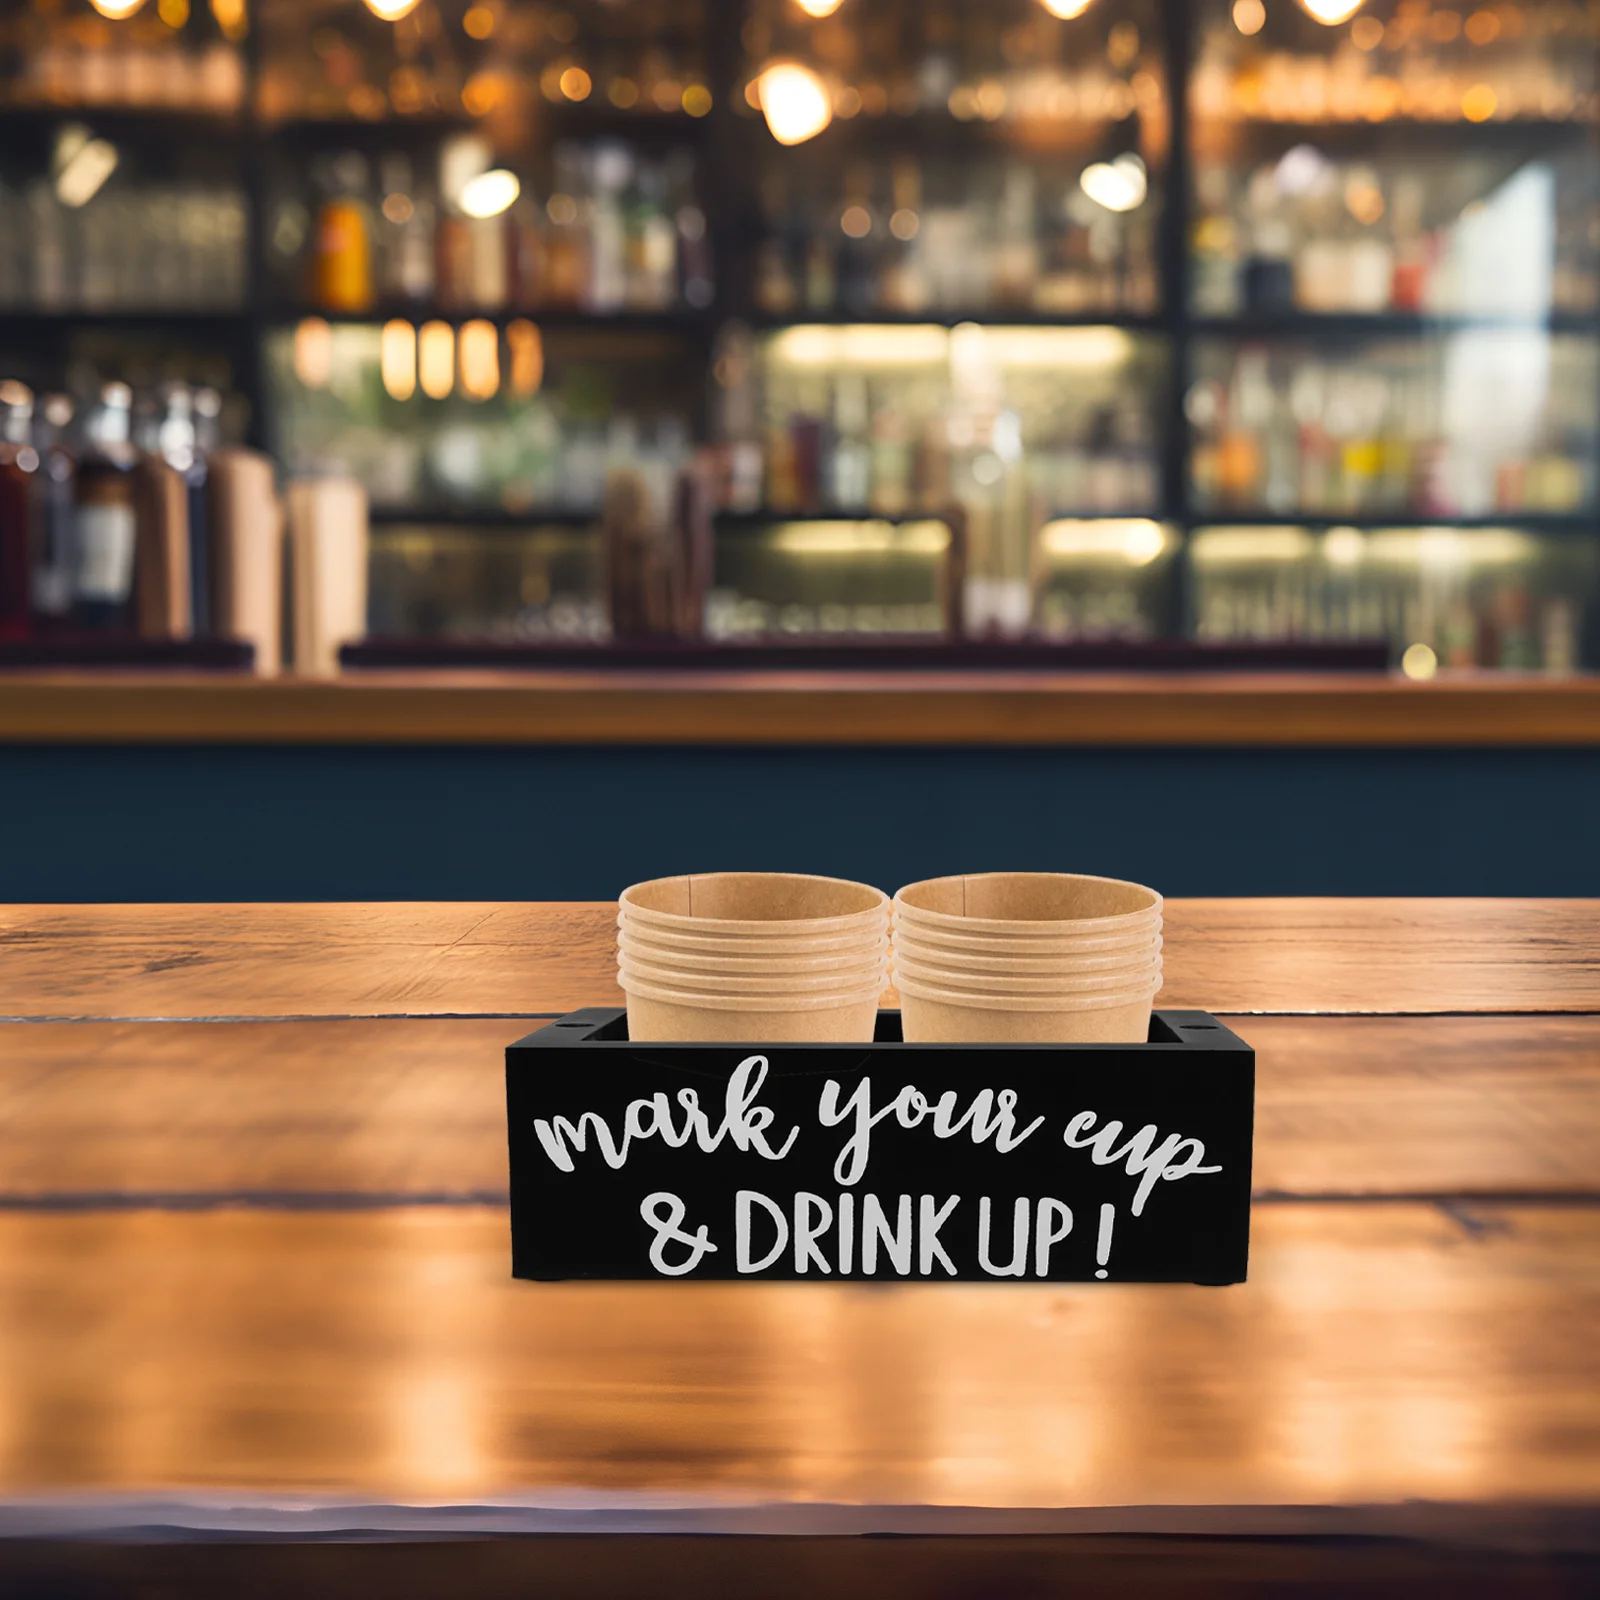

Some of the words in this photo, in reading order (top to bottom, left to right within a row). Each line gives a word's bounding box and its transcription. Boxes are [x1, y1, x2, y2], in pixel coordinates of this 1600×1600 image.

[534, 1055, 800, 1172] mark
[819, 1077, 1045, 1185] your
[1064, 1111, 1222, 1216] cup
[640, 1192, 717, 1276] &
[736, 1190, 960, 1277] DRINK
